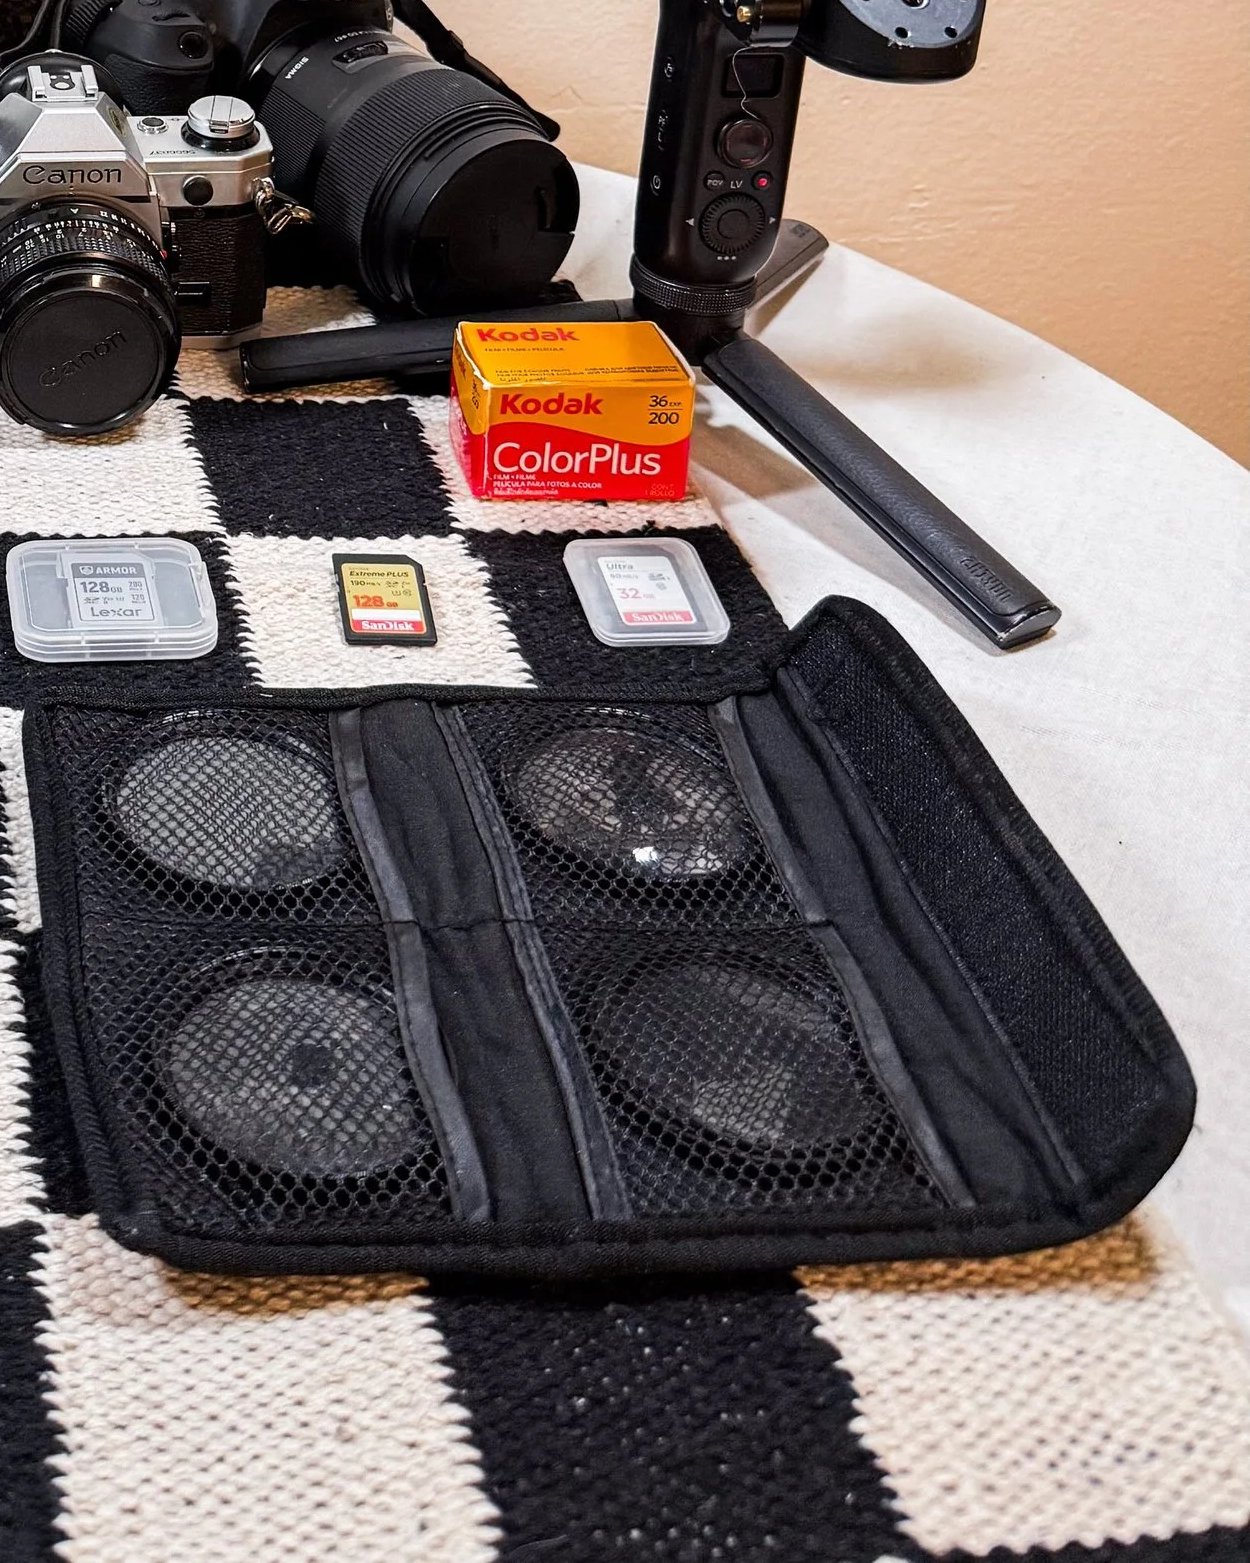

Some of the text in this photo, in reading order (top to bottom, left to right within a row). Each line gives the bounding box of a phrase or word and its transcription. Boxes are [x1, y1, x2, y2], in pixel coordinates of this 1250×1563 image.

[285, 56, 309, 79] SIGMA
[22, 165, 123, 185] Canon
[730, 180, 743, 189] LV
[476, 328, 580, 342] Kodak
[500, 392, 604, 416] Kodak
[648, 395, 668, 407] 36
[648, 412, 680, 425] 200
[493, 441, 661, 476] ColorPlus
[95, 566, 137, 575] ARMOR
[617, 587, 642, 599] 32
[352, 594, 385, 608] 128
[90, 606, 143, 617] Lexar
[632, 612, 684, 622] SanDisk
[361, 620, 415, 631] SanDisk
